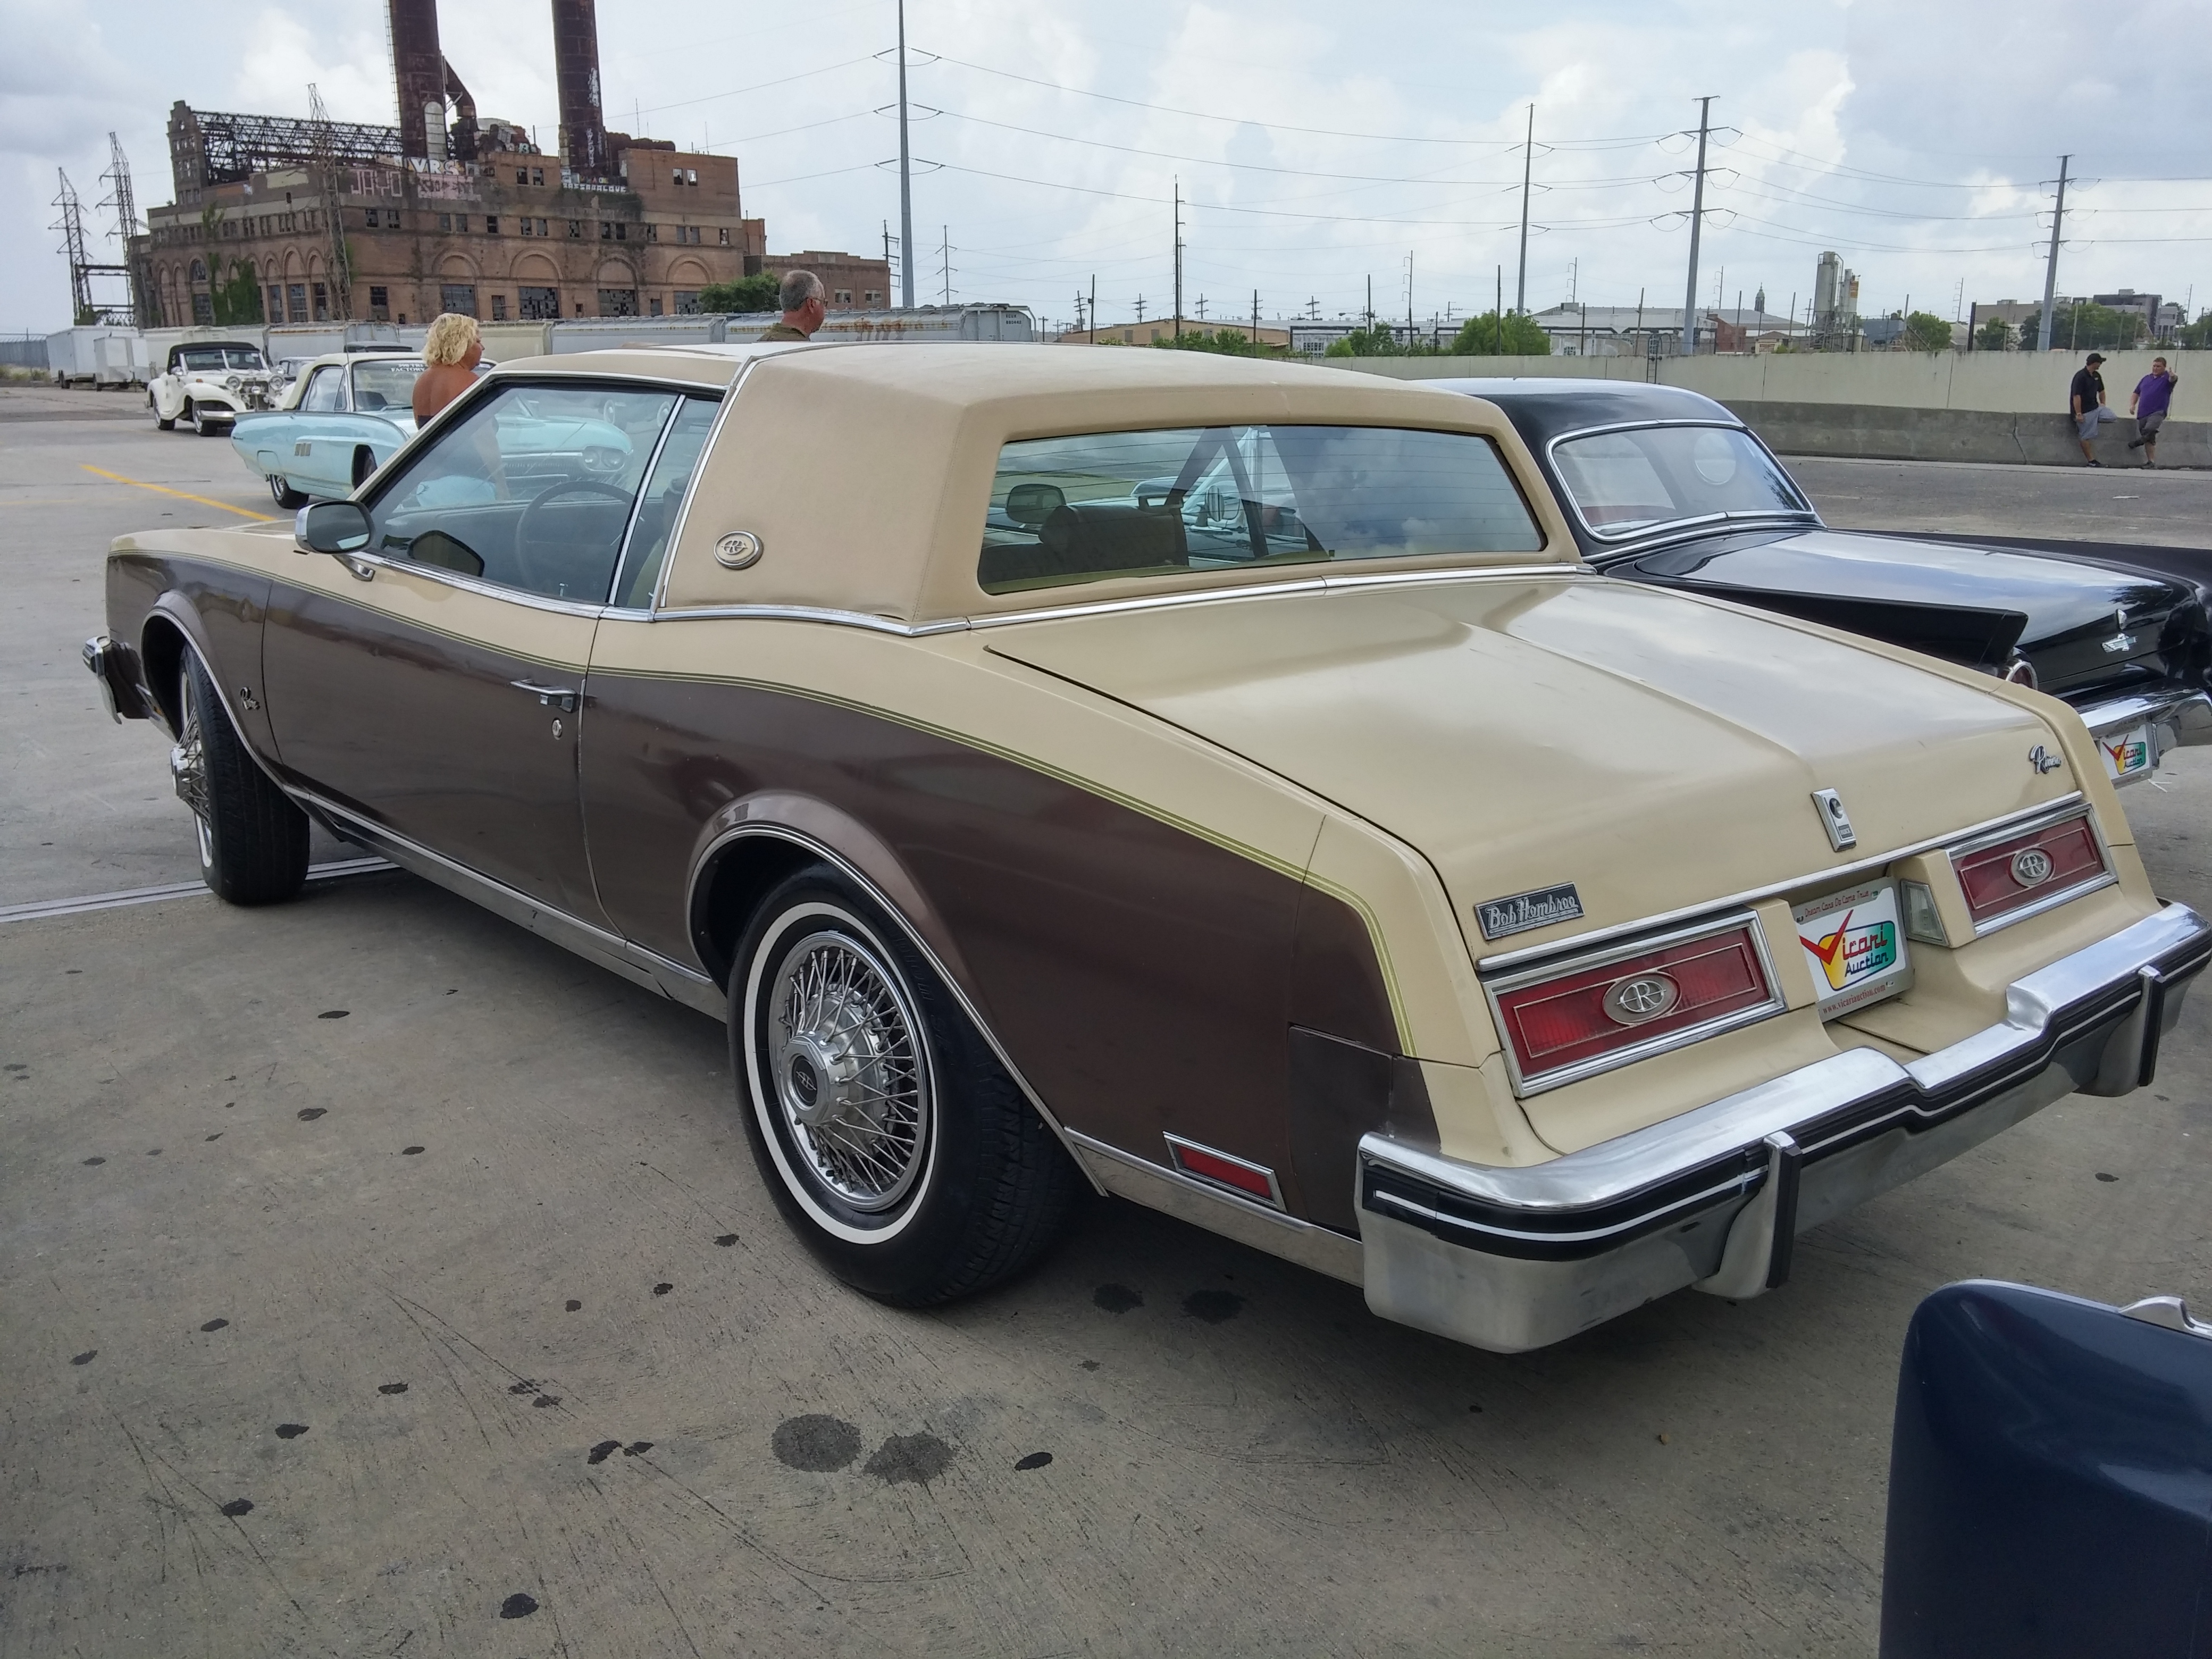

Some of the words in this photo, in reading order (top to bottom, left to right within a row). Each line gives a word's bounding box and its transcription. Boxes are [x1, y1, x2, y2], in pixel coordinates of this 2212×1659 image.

[1485, 903, 1516, 930] Bob
[1805, 907, 1821, 917] Dream
[1834, 898, 1841, 907] Do
[1841, 894, 1856, 903] Come
[1856, 890, 1870, 899] True
[1845, 952, 1889, 977] Auction
[1822, 985, 1886, 1015] www.vicariauction.com
